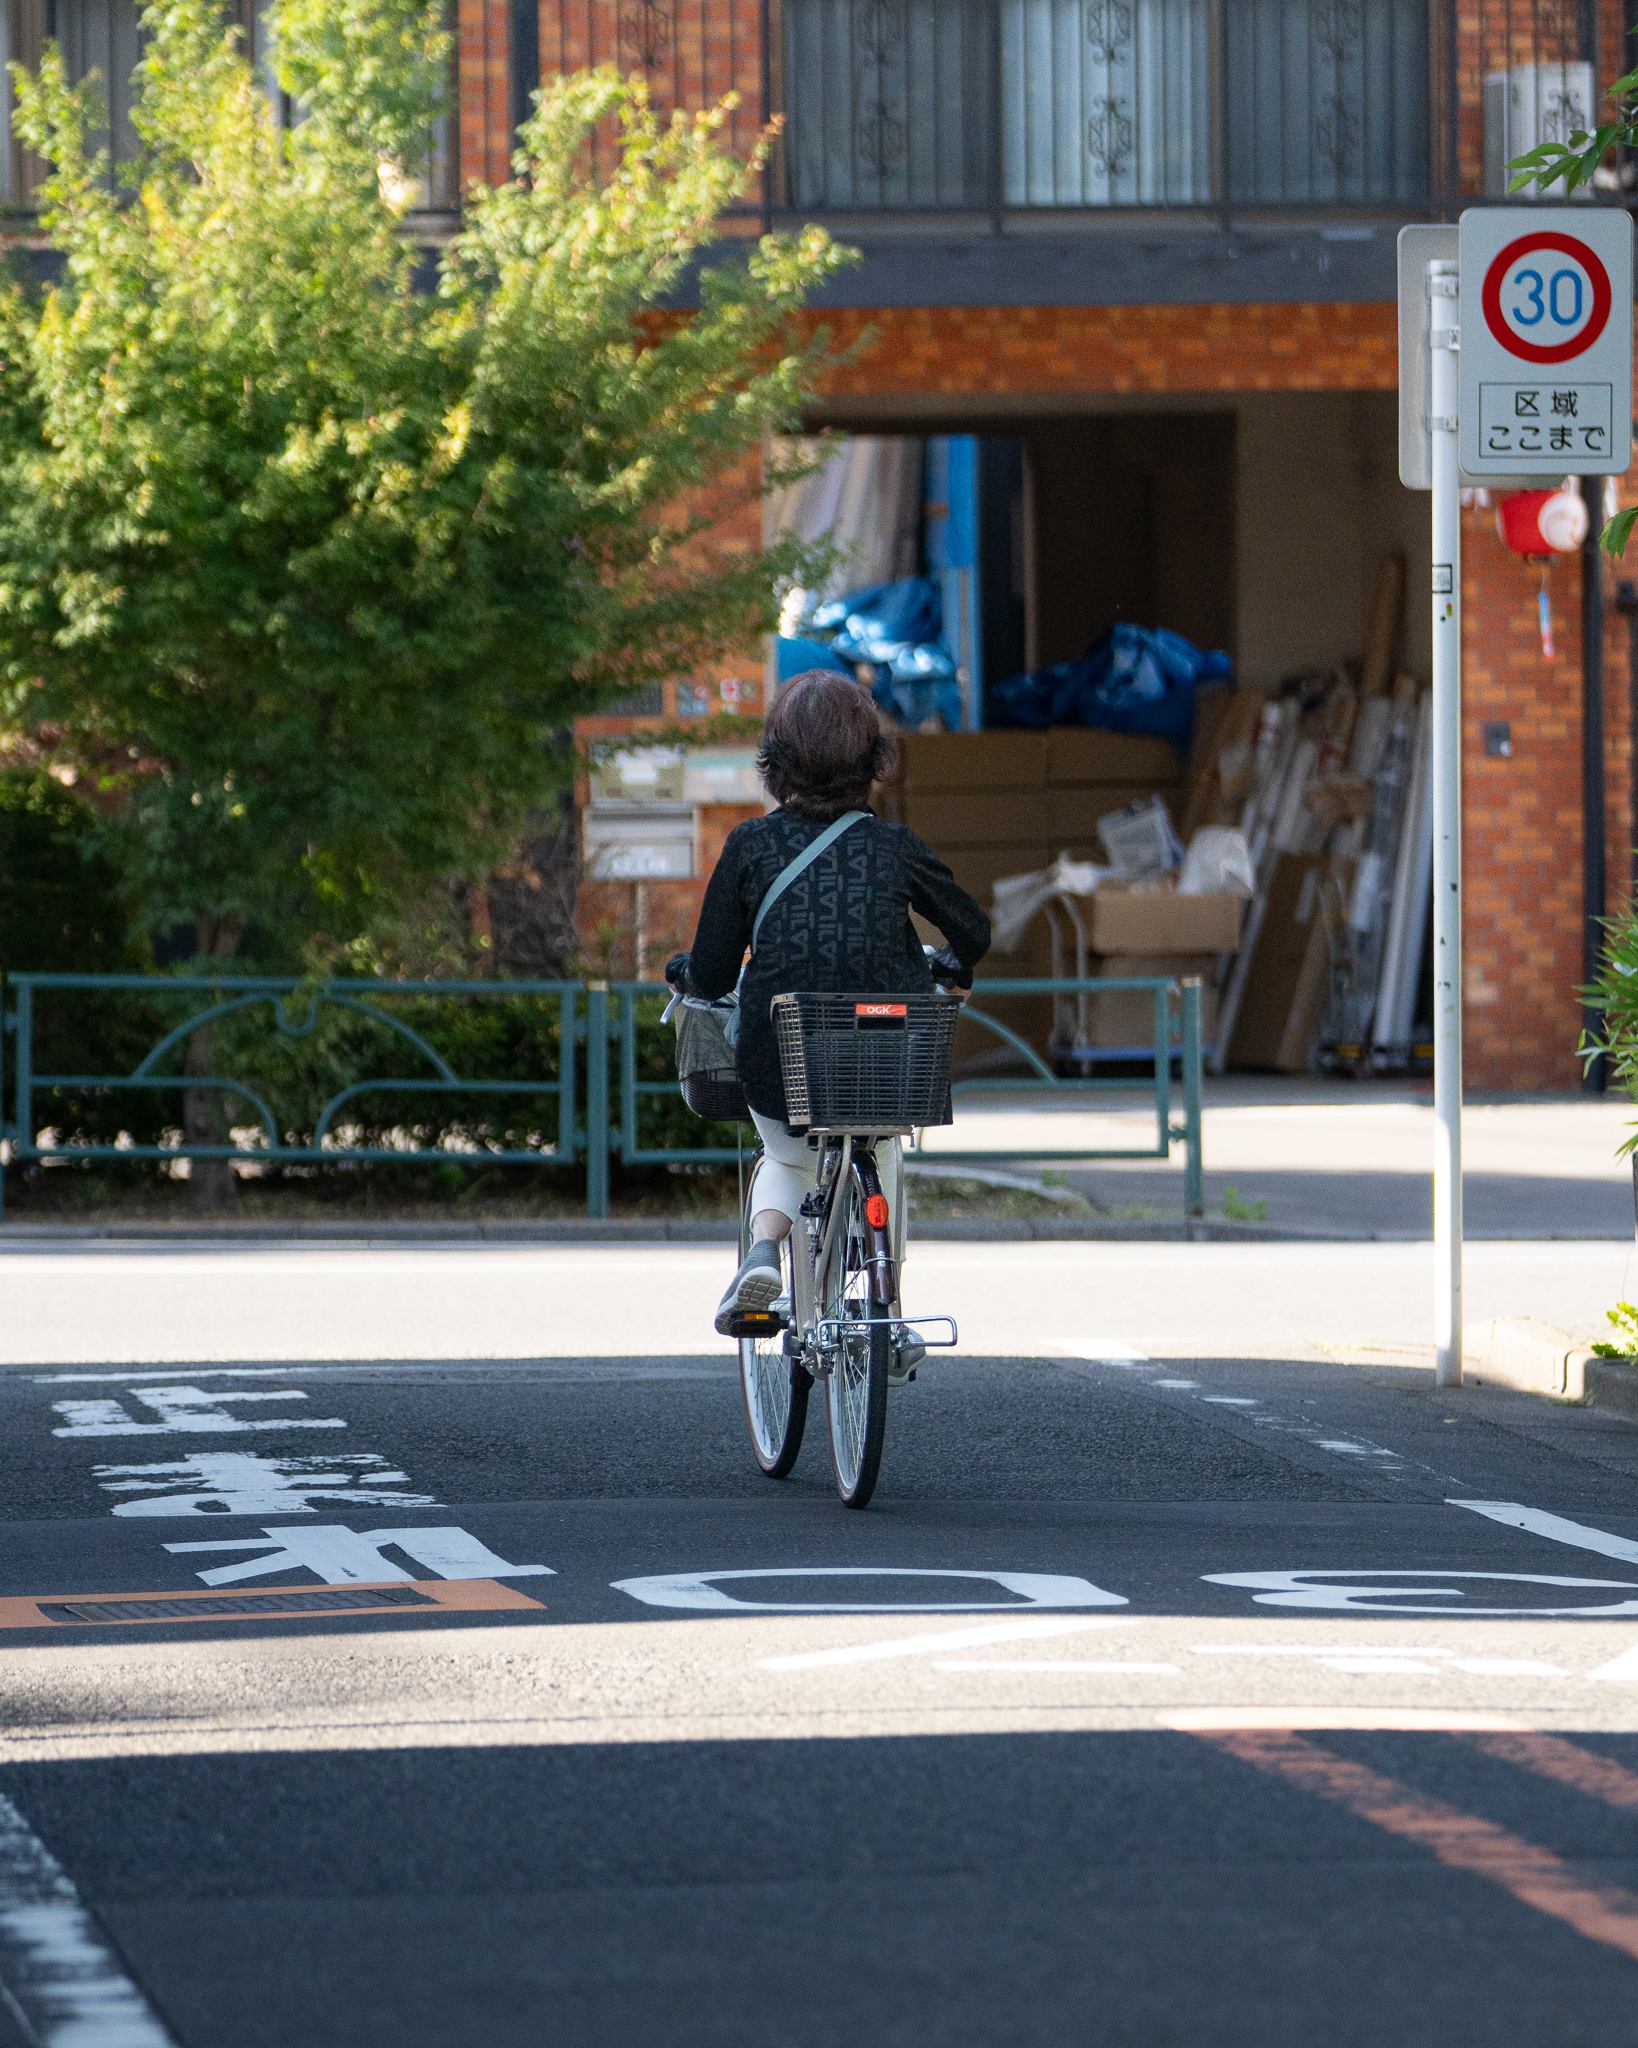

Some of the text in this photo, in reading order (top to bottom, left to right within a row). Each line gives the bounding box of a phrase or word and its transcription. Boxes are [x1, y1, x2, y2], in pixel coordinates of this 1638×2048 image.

[1512, 269, 1582, 326] 30
[1515, 391, 1578, 417] 区域
[1489, 425, 1605, 451] ここまで
[866, 1005, 892, 1015] OGK
[51, 1386, 557, 1586] 止まれ
